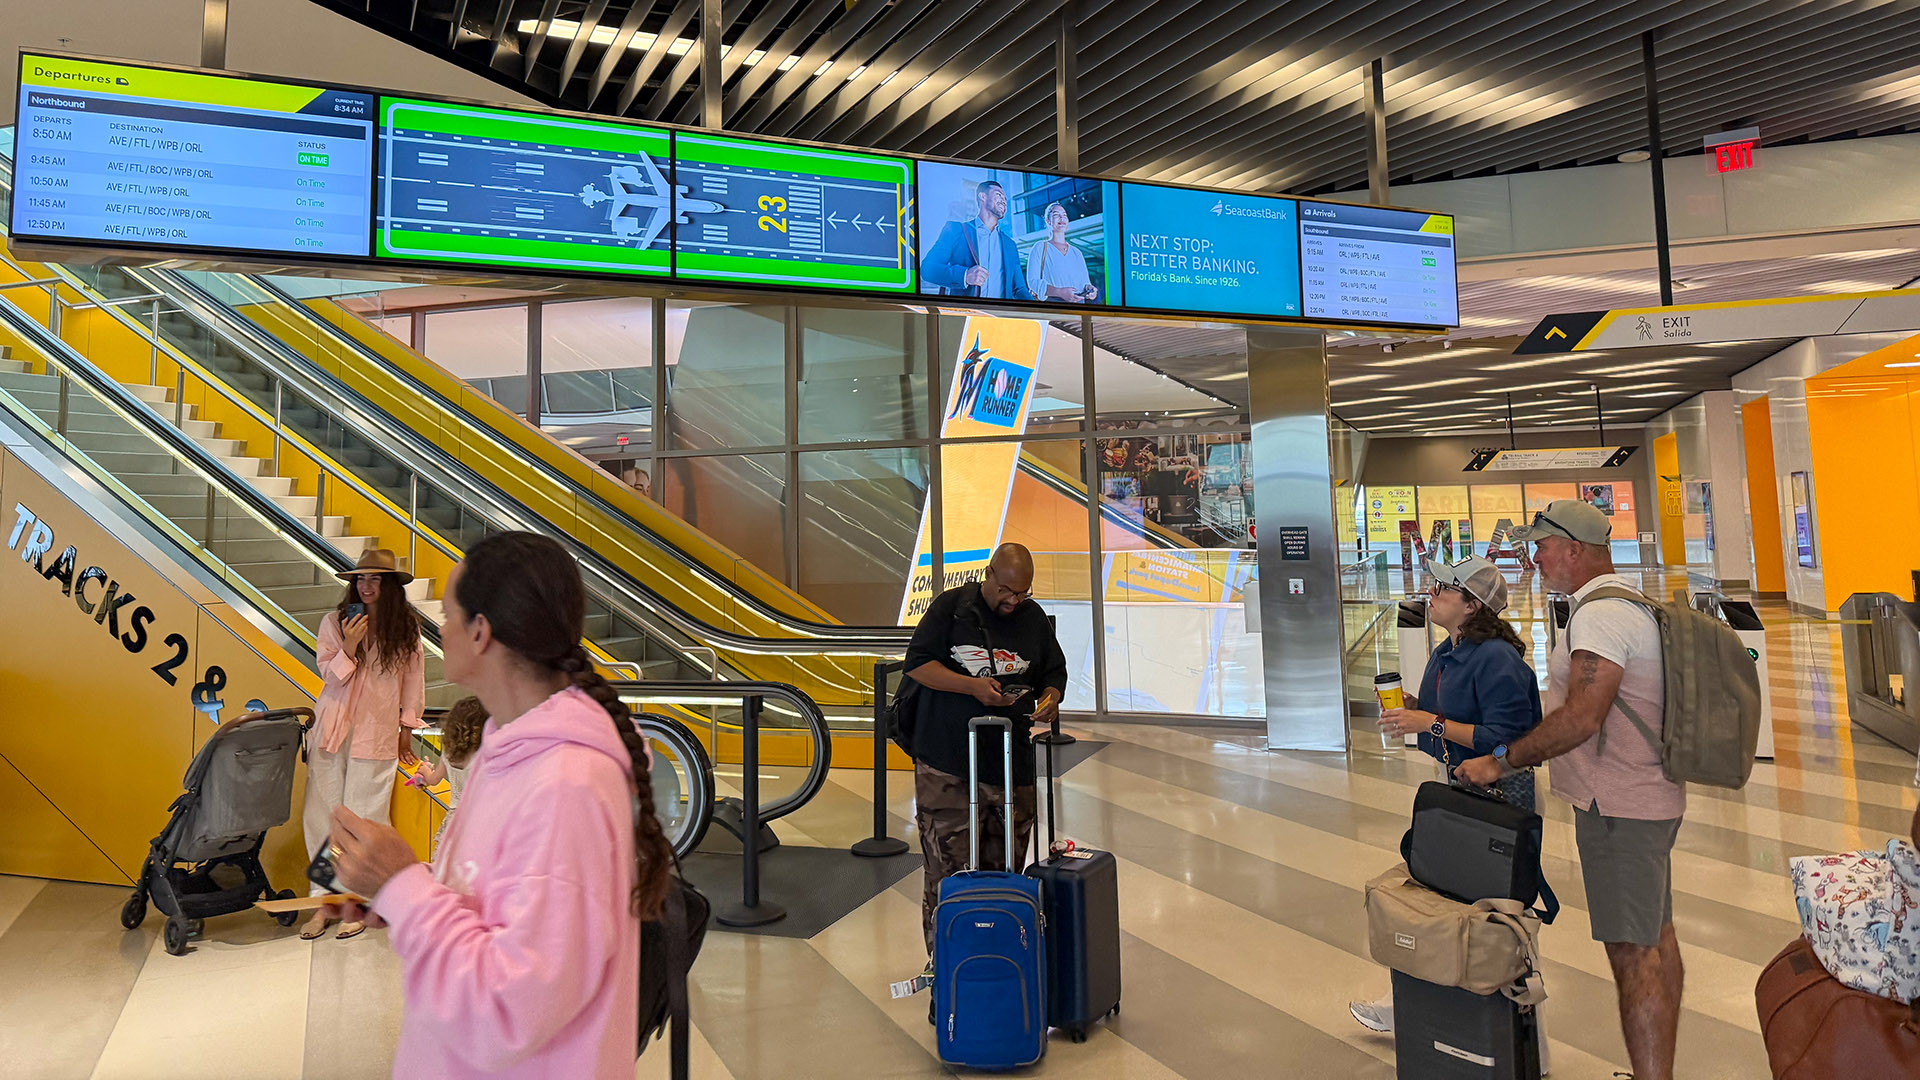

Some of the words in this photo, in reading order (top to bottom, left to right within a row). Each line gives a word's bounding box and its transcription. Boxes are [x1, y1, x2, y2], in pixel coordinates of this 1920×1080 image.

[34, 66, 111, 84] Departures
[31, 95, 86, 109] Northbound
[334, 105, 350, 113] 8:34
[351, 106, 364, 114] AM
[33, 115, 72, 125] DEPARTS
[109, 122, 163, 134] DESTINATION
[298, 141, 326, 149] STATUS
[32, 128, 55, 139] 8:50
[56, 130, 72, 141] AM
[109, 136, 127, 146] AVE
[134, 138, 150, 148] FTL
[157, 140, 179, 151] WPB
[185, 142, 203, 153] ORL
[300, 154, 311, 163] ON
[312, 156, 328, 164] TIME
[1715, 141, 1753, 173] EXIT
[31, 155, 51, 164] 9:45
[52, 157, 66, 166] AM
[107, 162, 124, 171] AVE
[130, 164, 144, 172] FTL
[150, 165, 168, 175] BOC
[174, 167, 192, 177] WPB
[198, 169, 214, 178] ORL
[297, 178, 307, 186] On
[308, 179, 325, 188] Time
[30, 176, 53, 186] 10:50
[55, 178, 69, 187] AM
[106, 182, 122, 191] AVE
[129, 184, 143, 193] FTL
[149, 186, 168, 195] WPB
[173, 188, 189, 197] ORL
[308, 199, 325, 207] Time
[29, 198, 51, 207] 11:45
[52, 199, 66, 208] AM
[105, 204, 121, 213] AVE
[127, 205, 142, 214] FTL
[148, 207, 166, 216] BOC
[172, 208, 190, 218] WPB
[196, 210, 212, 219] ORL
[295, 217, 306, 225] On
[307, 219, 324, 227] Time
[758, 195, 786, 233] 23
[1225, 205, 1287, 220] SeacoastBank
[1312, 209, 1336, 218] Arrivals
[27, 220, 51, 229] 12:50
[52, 221, 65, 230] PM
[104, 225, 120, 234] AVE
[126, 226, 141, 235] FTL
[147, 228, 166, 237] WPB
[171, 229, 188, 238] ORL
[295, 238, 305, 246] On
[307, 239, 323, 247] Time
[1130, 233, 1168, 250] NEXT
[1174, 237, 1214, 254] STOP:
[1131, 252, 1188, 270] BETTER
[1193, 256, 1259, 275] BANKING.
[1131, 271, 1168, 283] Florida's
[1170, 274, 1193, 284] Bank.
[1195, 275, 1217, 286] Since
[1220, 277, 1240, 287] 1926.
[1663, 317, 1690, 328] EXIT
[1664, 329, 1691, 338] Salida
[981, 396, 1016, 418] RUNNER
[7, 502, 155, 654] TRACKS
[150, 633, 188, 687] 2
[191, 666, 227, 725] &
